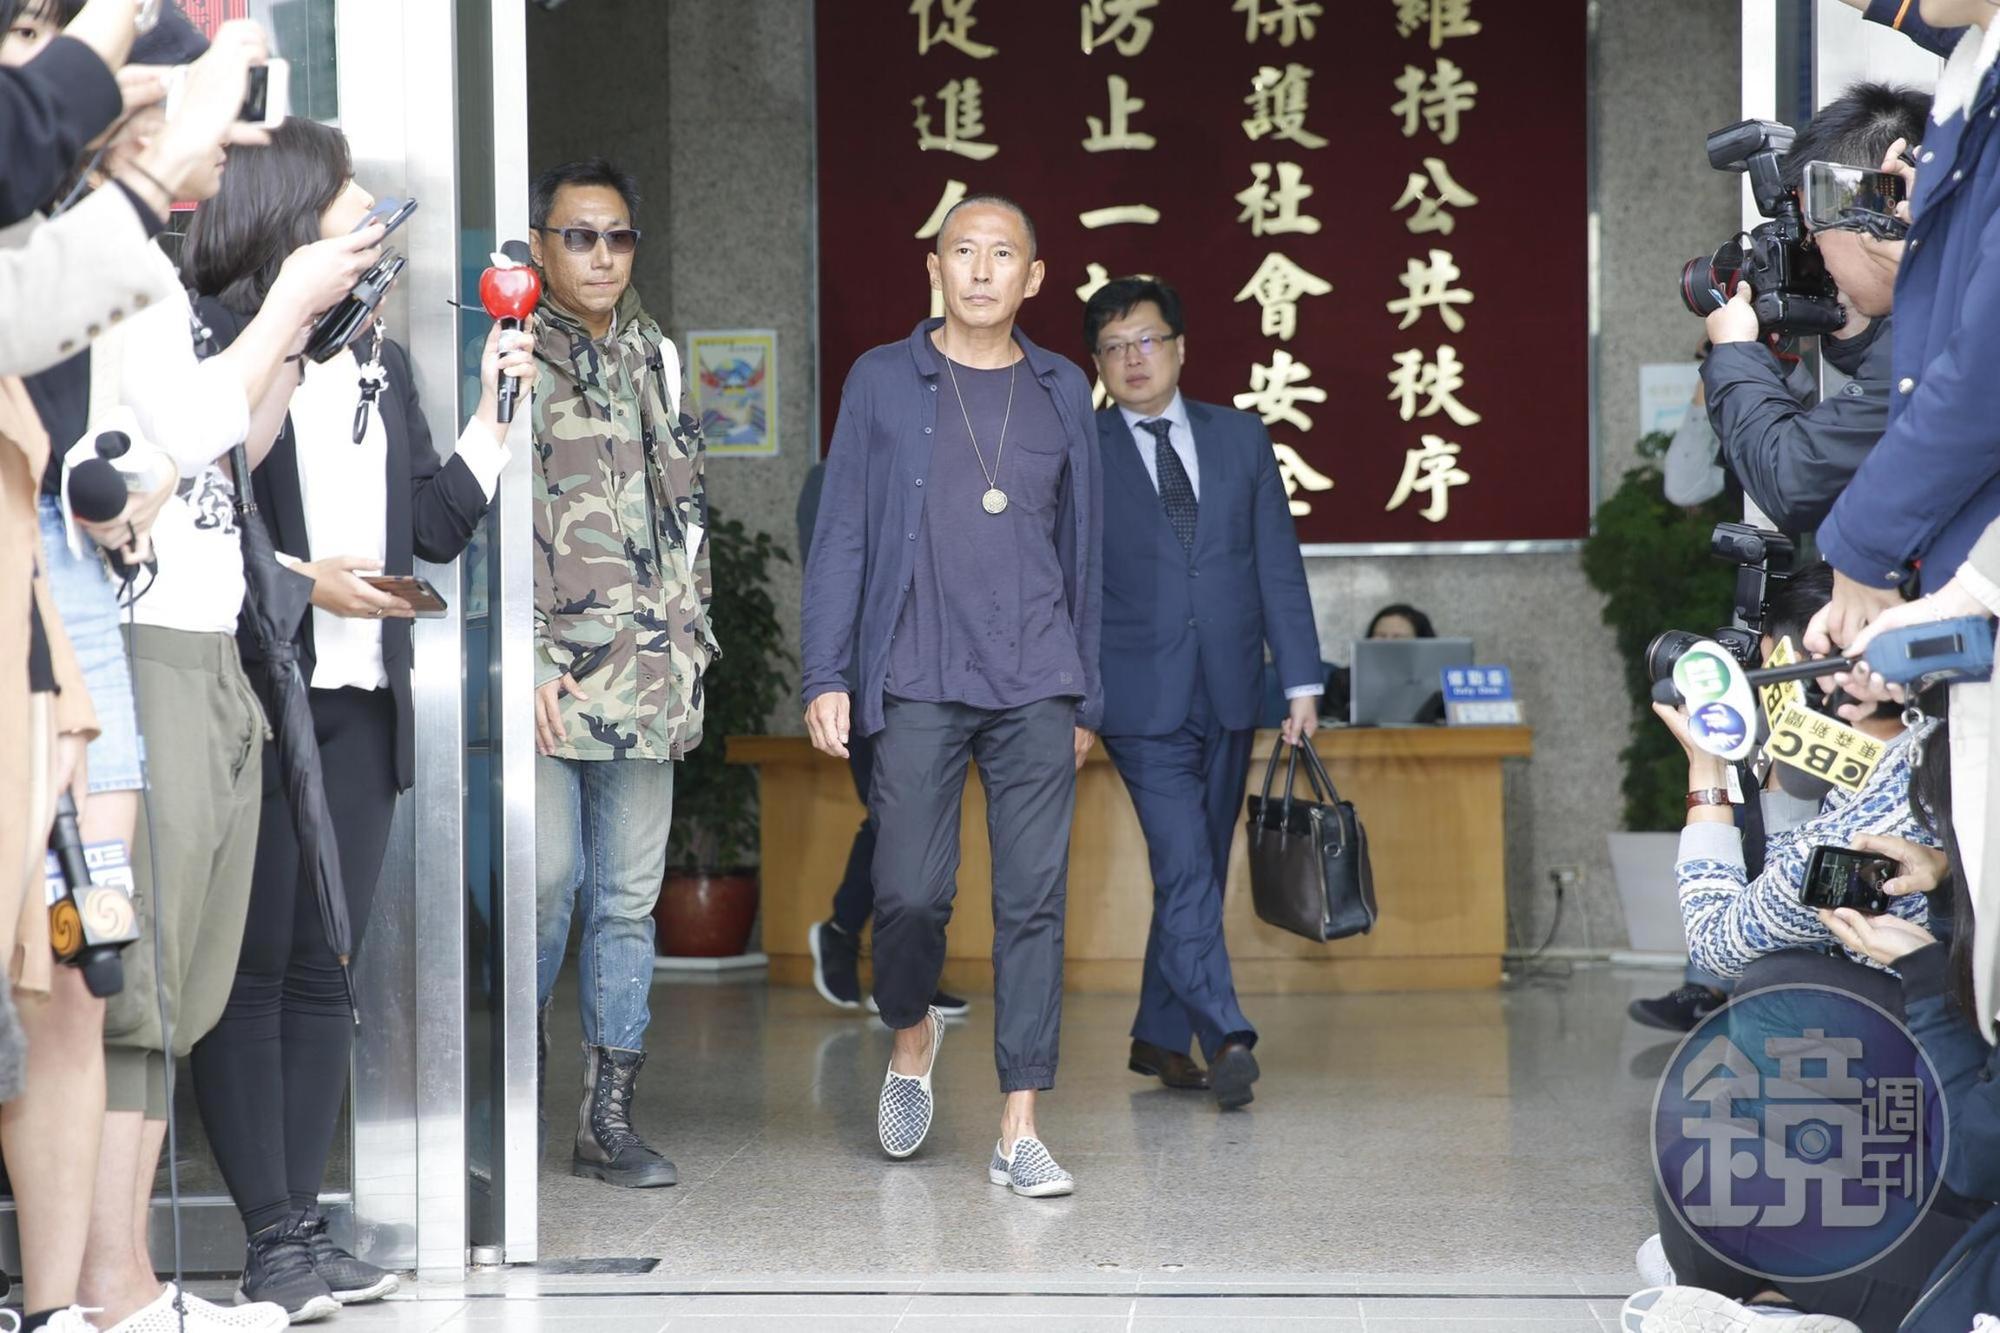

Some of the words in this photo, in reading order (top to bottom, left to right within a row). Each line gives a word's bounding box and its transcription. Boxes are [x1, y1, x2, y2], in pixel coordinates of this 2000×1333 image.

[1772, 730, 1870, 789] EBC
[1784, 711, 1880, 760] 東森新聞
